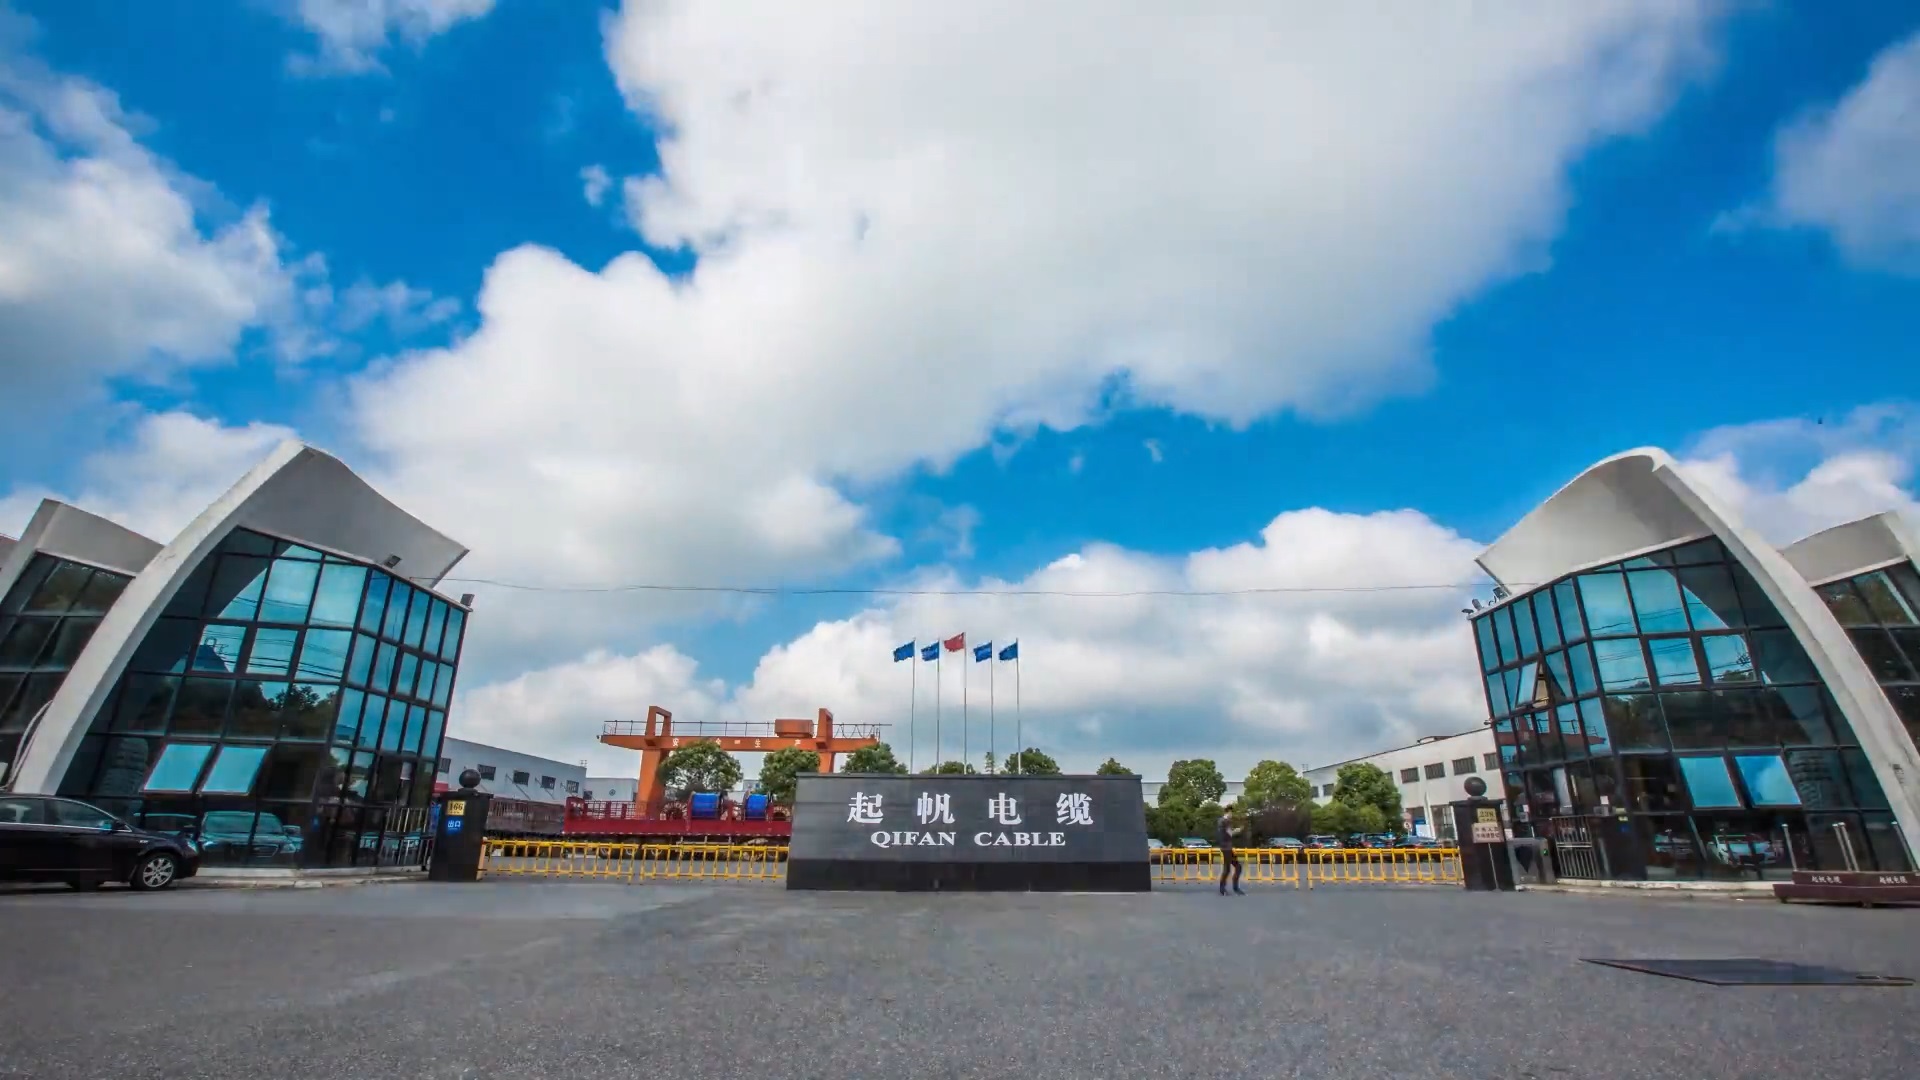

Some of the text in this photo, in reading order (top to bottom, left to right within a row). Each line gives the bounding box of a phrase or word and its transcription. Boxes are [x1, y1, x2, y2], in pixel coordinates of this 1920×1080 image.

[846, 791, 1094, 825] 起帆电缆
[447, 820, 461, 828] 出口
[870, 831, 1066, 848] QIFAN CABLE
